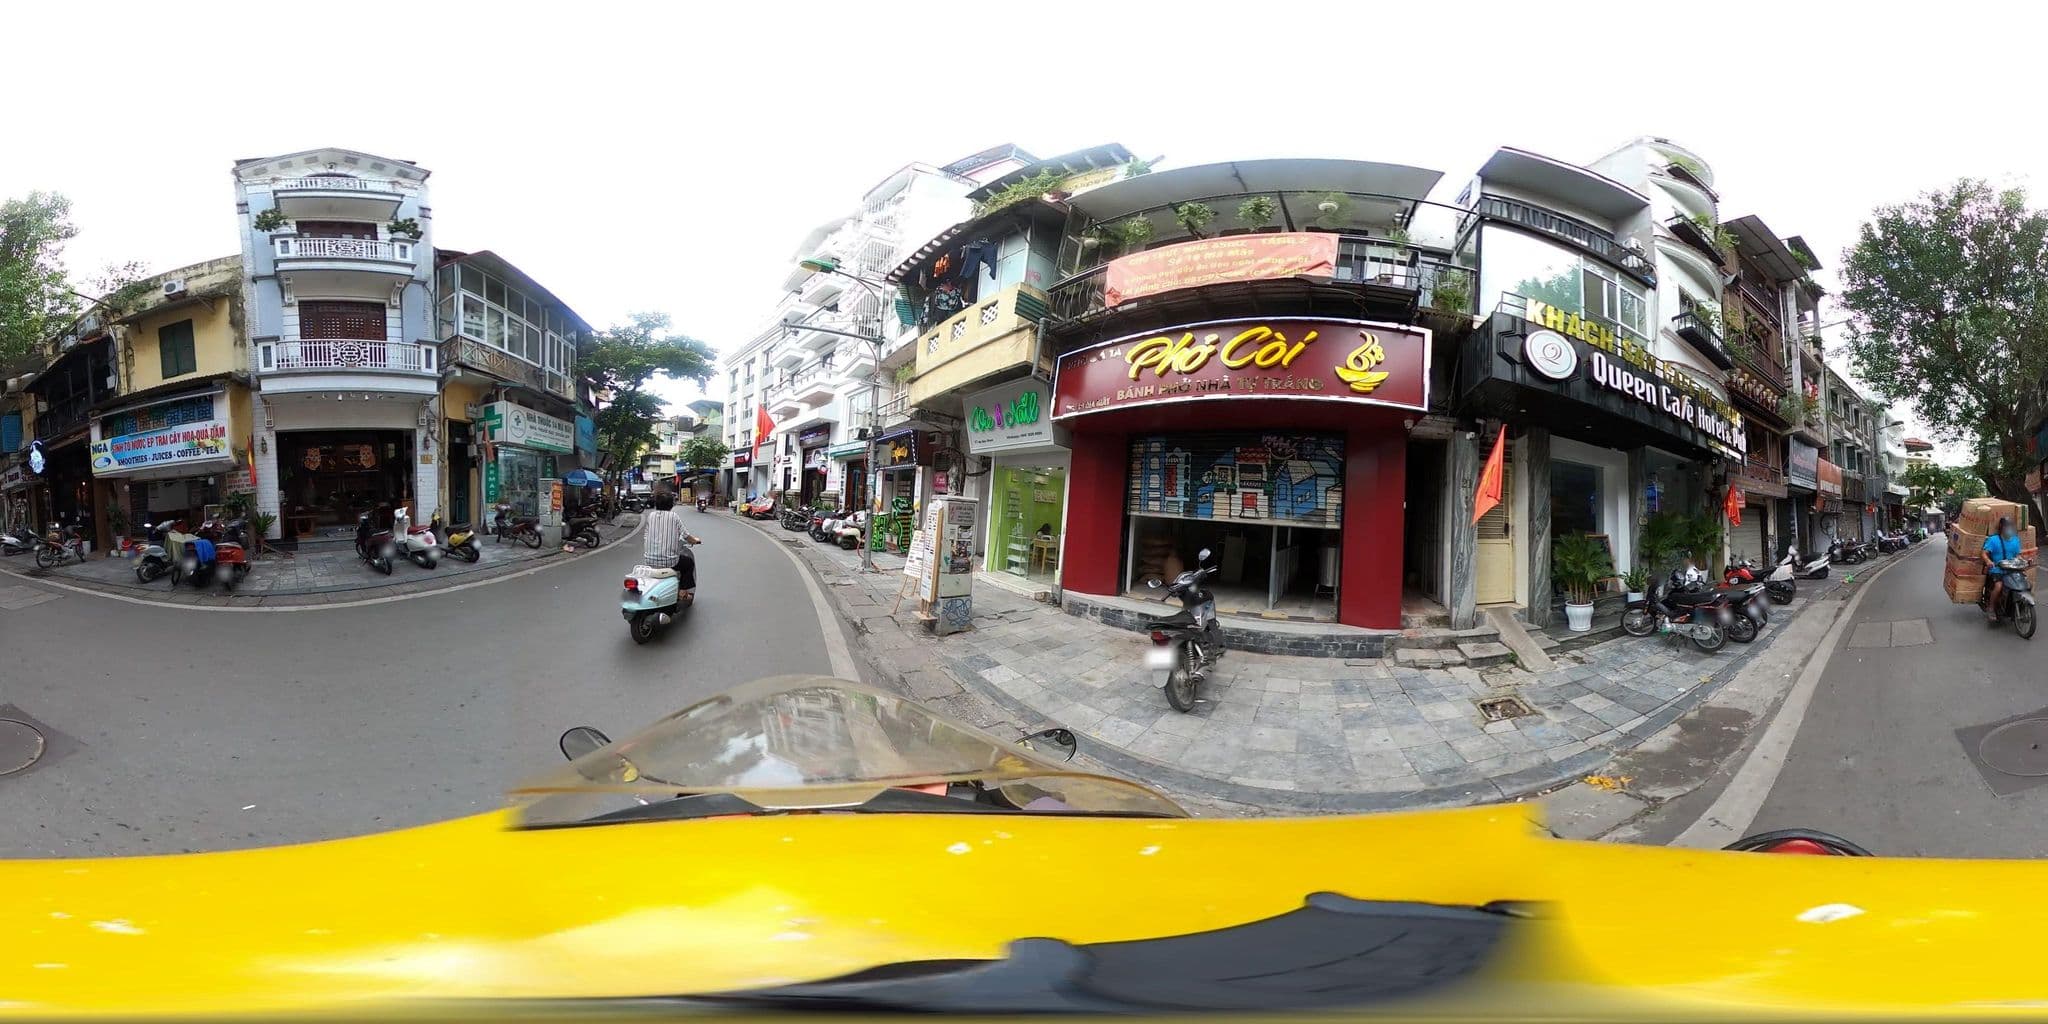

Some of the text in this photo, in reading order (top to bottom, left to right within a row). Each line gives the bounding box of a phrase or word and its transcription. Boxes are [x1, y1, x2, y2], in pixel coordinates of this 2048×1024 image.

[1526, 298, 1614, 353] KHÁCH
[1124, 326, 1319, 381] Phở Còi
[1117, 384, 1154, 401] BÁNH
[1196, 375, 1231, 392] NHÀ
[1593, 351, 1657, 406] Queen
[1698, 406, 1726, 441] Hotel
[92, 443, 108, 455] NGA
[118, 445, 219, 467] SMOOTHIES JUICES COFFEE TEA
